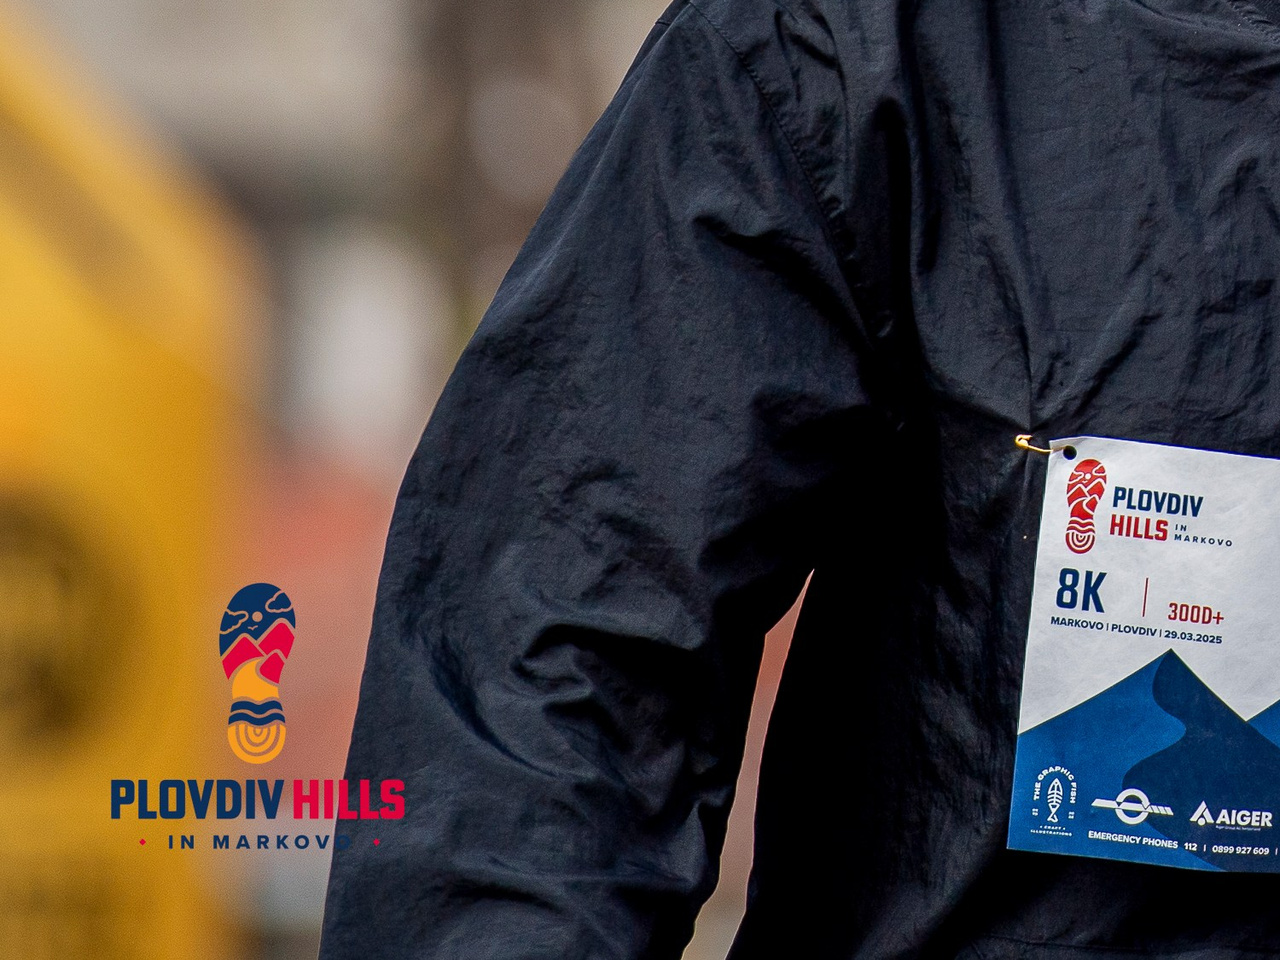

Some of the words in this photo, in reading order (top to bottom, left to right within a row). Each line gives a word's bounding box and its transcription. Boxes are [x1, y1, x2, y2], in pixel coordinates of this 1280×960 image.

[1112, 486, 1204, 518] PLOVDIV
[1109, 514, 1169, 541] HILLS
[1174, 523, 1188, 532] IN
[1174, 533, 1233, 547] MARKOVO
[1055, 567, 1108, 614] 8K
[1050, 616, 1104, 631] MARKOVO
[1111, 623, 1158, 637] PLOVDIV
[1163, 629, 1223, 644] 29.03.2025
[1033, 782, 1041, 801] THE
[1037, 765, 1075, 781] GRAPHIC
[1069, 782, 1077, 804] FISH
[1215, 809, 1273, 827] AIGER
[1088, 830, 1141, 844] EMERGENCY
[1142, 838, 1179, 849] PHONES
[1183, 842, 1198, 851] 112
[1235, 846, 1252, 855] 927
[1252, 847, 1270, 856] 609
